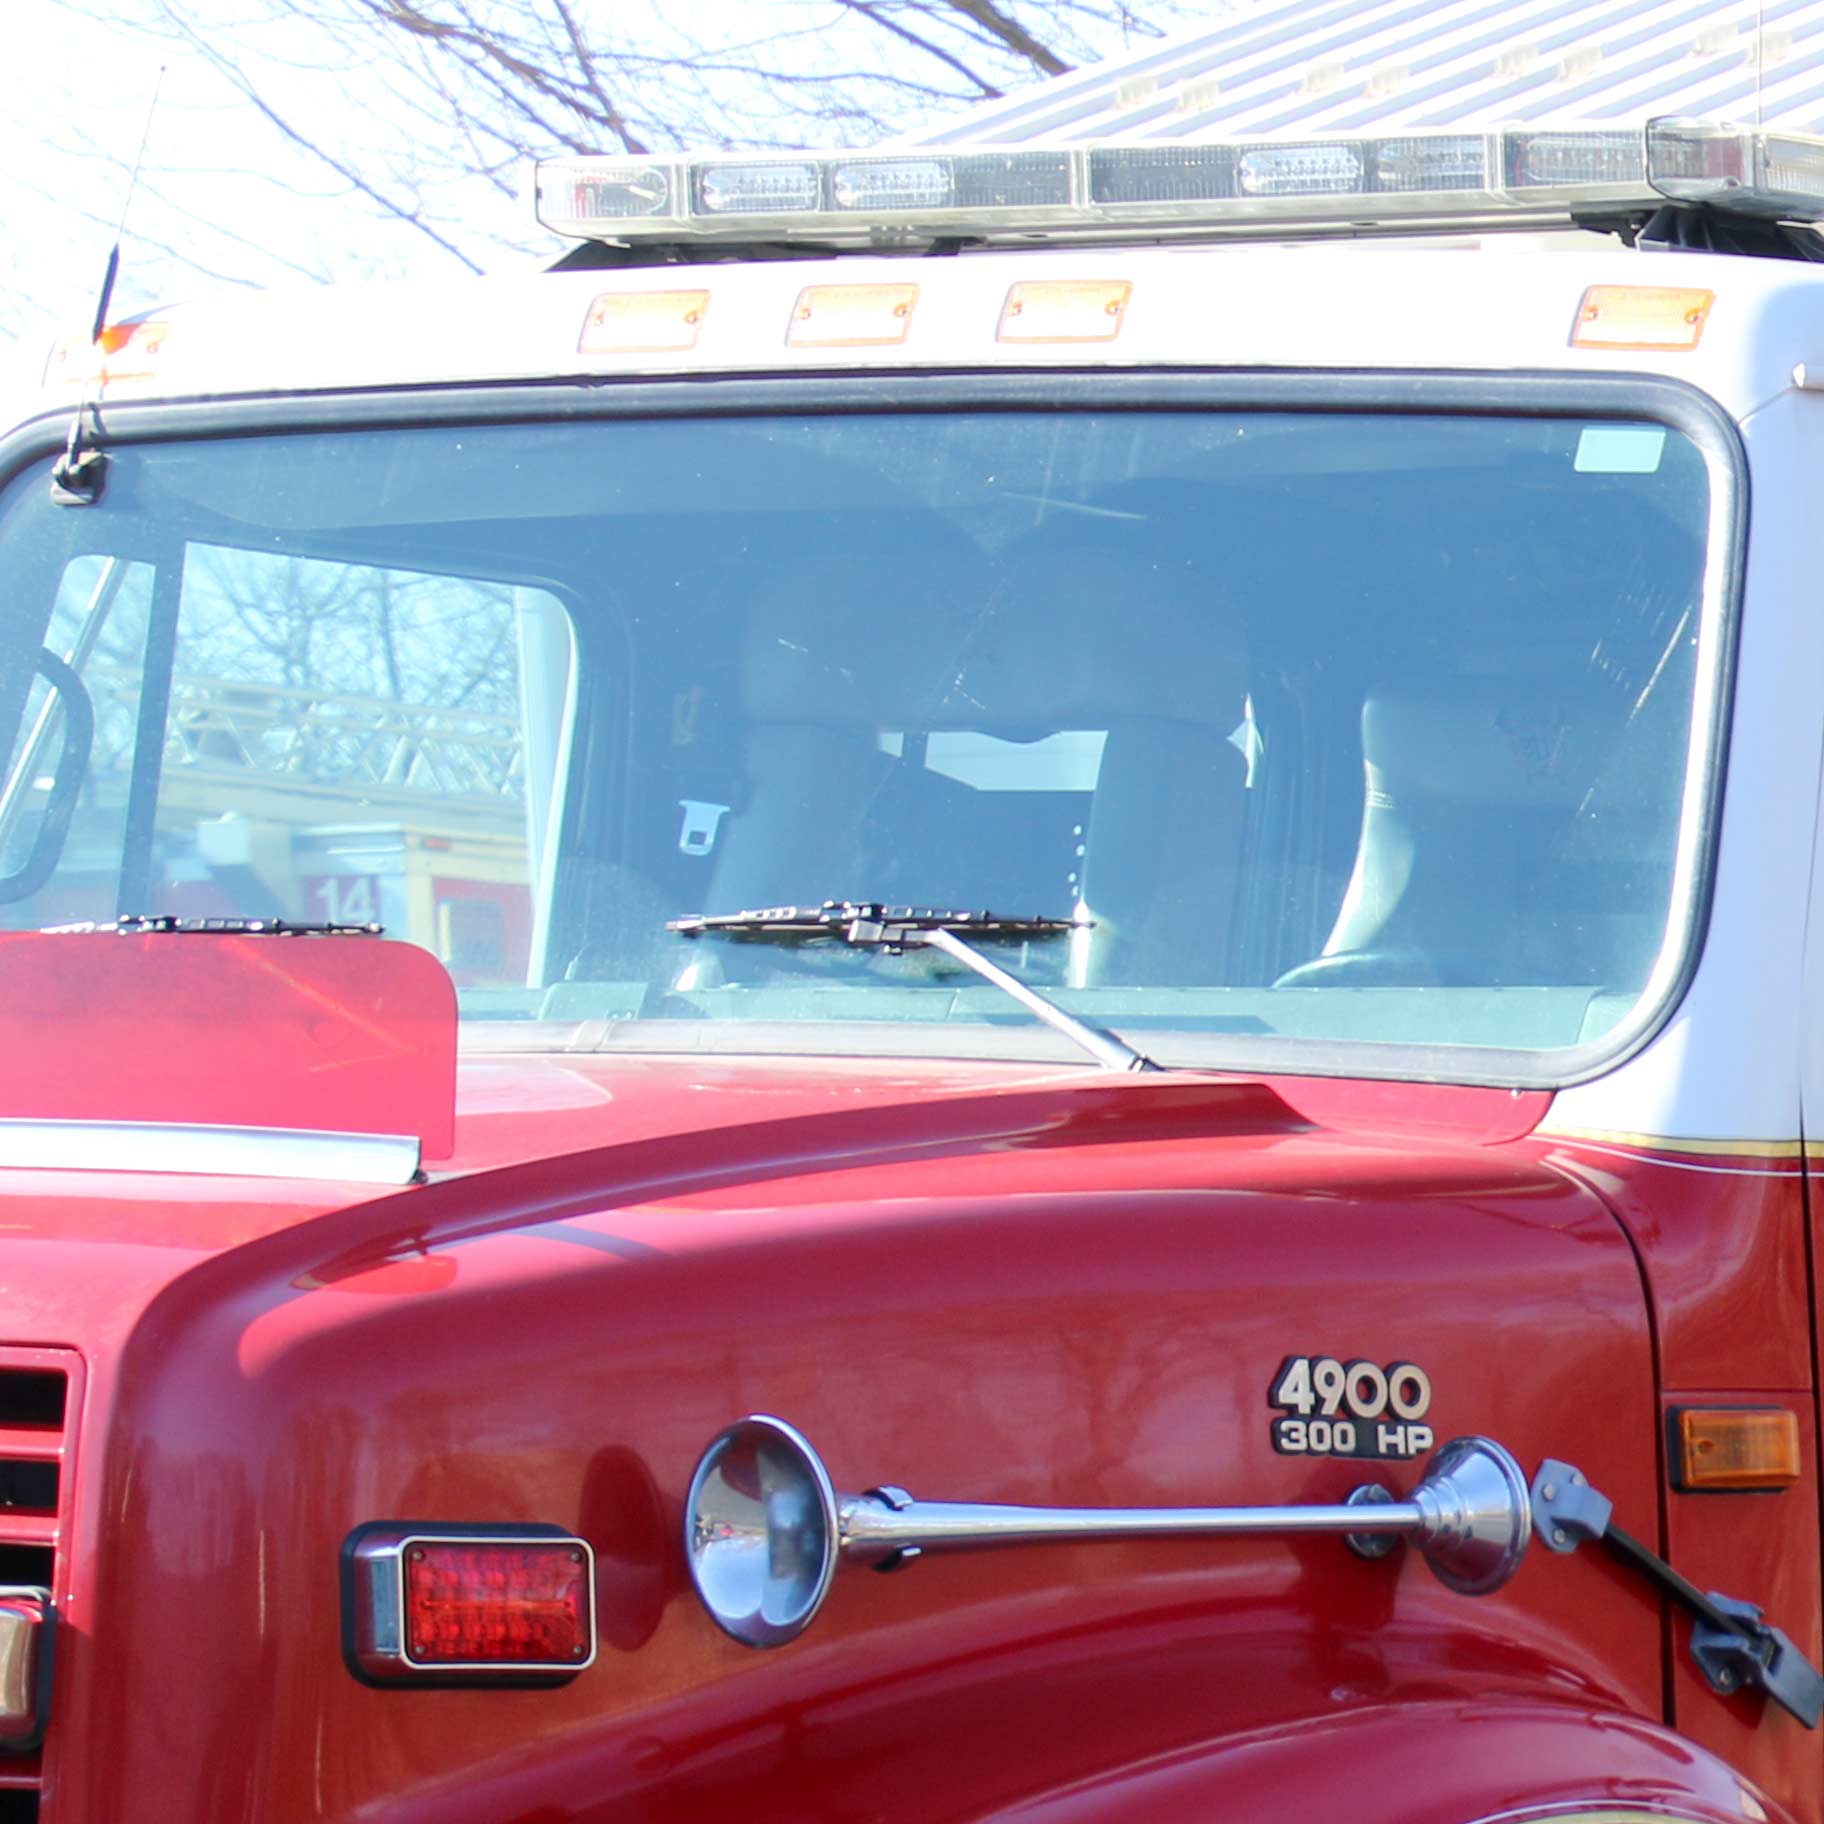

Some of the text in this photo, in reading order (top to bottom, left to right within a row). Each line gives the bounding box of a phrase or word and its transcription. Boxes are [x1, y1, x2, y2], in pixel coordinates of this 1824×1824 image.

[316, 877, 374, 926] 14
[1277, 1357, 1432, 1421] 4900
[1279, 1420, 1434, 1455] 300 HP
